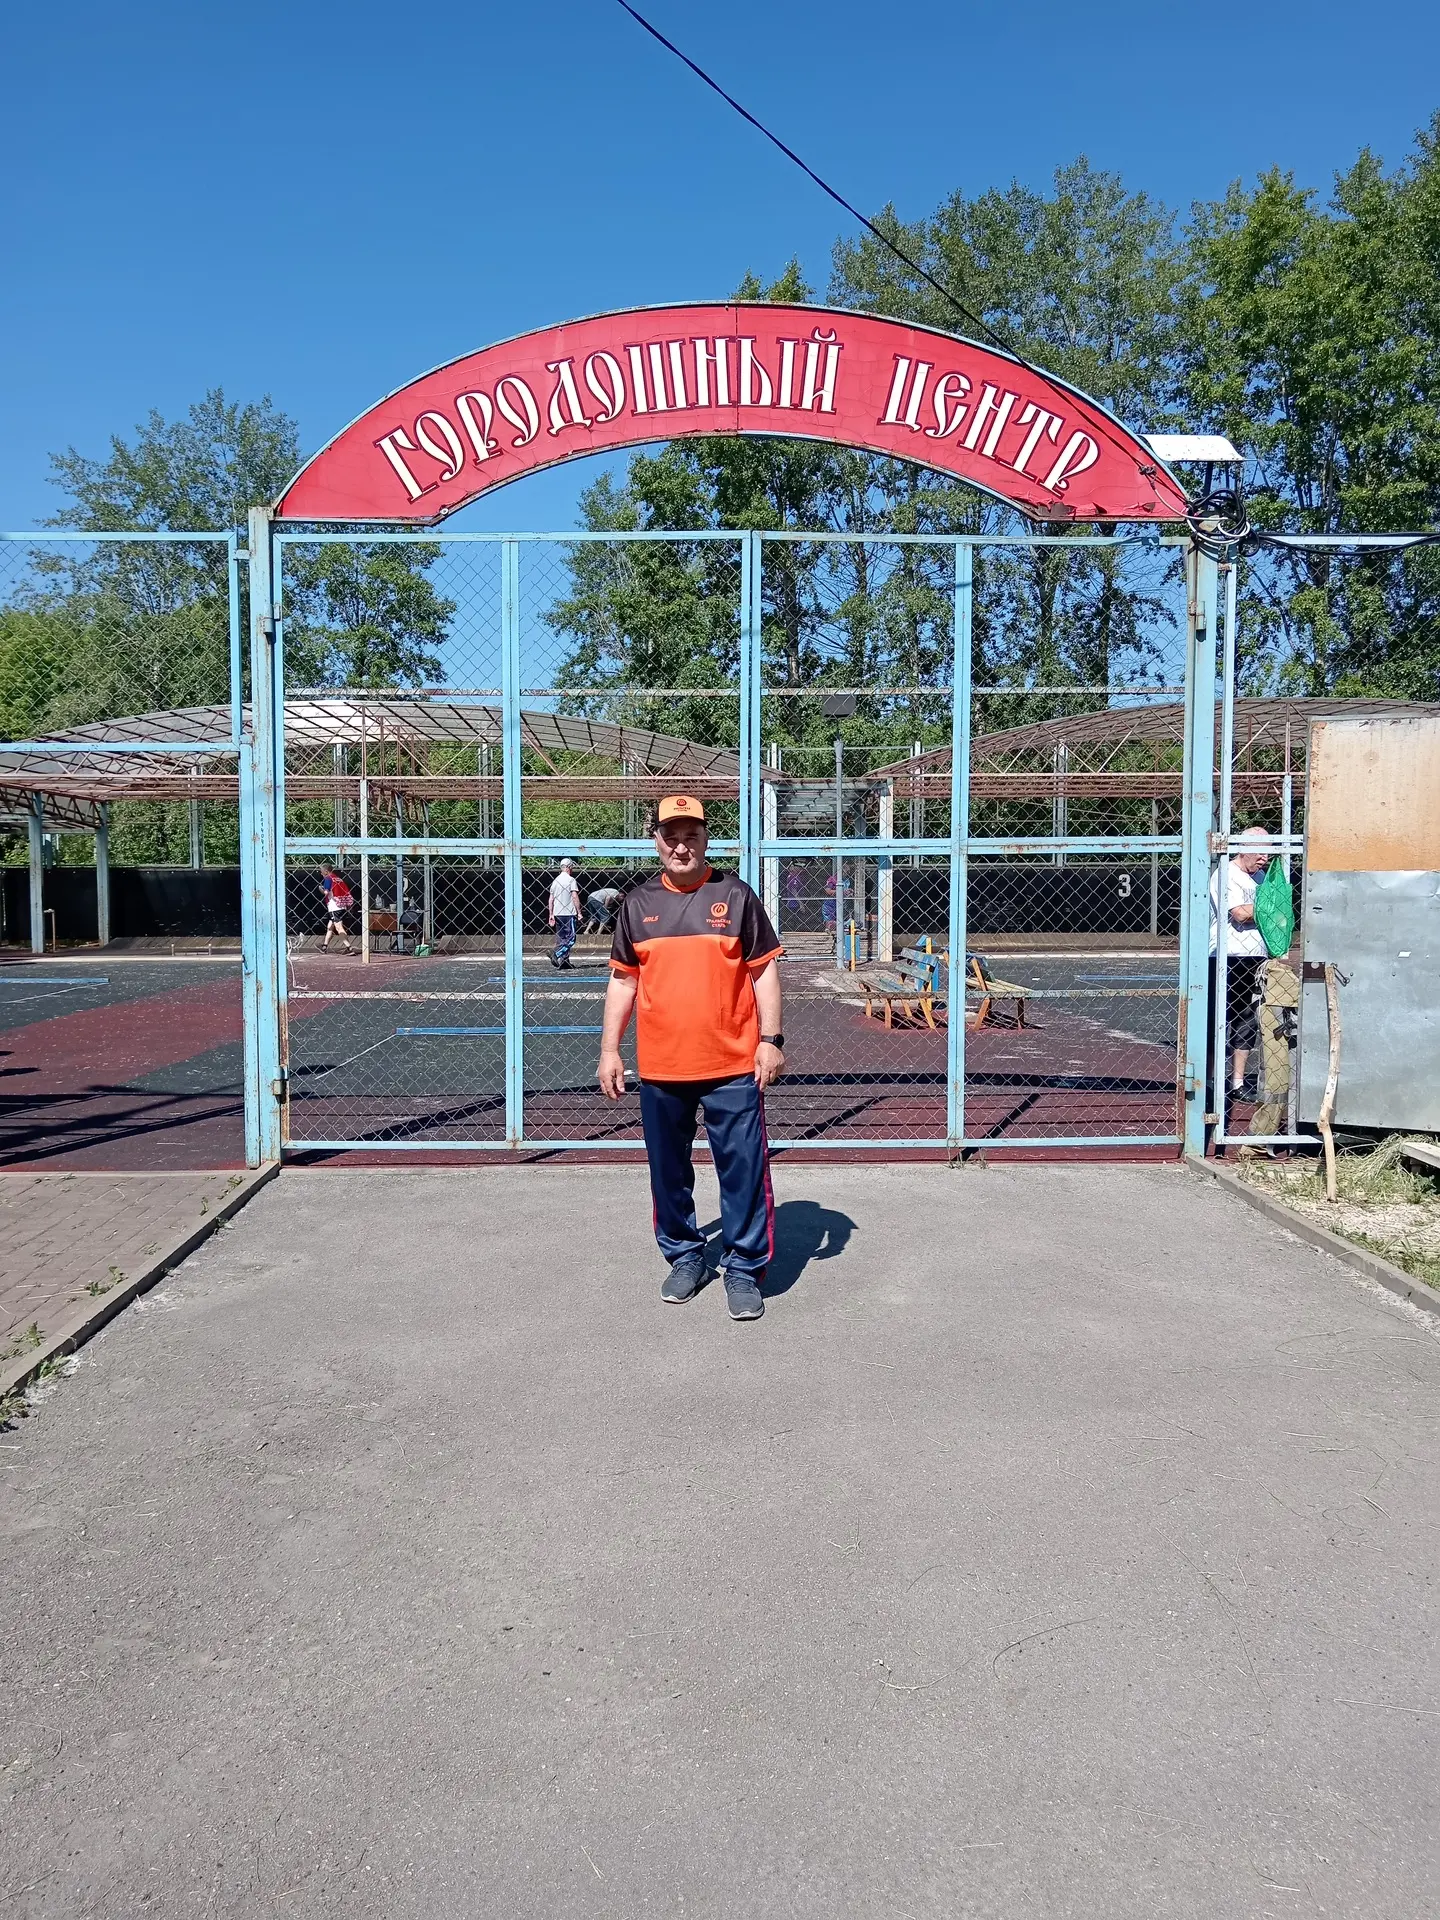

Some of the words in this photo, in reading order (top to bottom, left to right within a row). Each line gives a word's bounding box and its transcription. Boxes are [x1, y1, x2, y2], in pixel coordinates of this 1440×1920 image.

[372, 326, 844, 504] ГОРОДОШНЫЙ
[878, 353, 1101, 499] ЦЕНТР
[1118, 873, 1131, 897] 3
